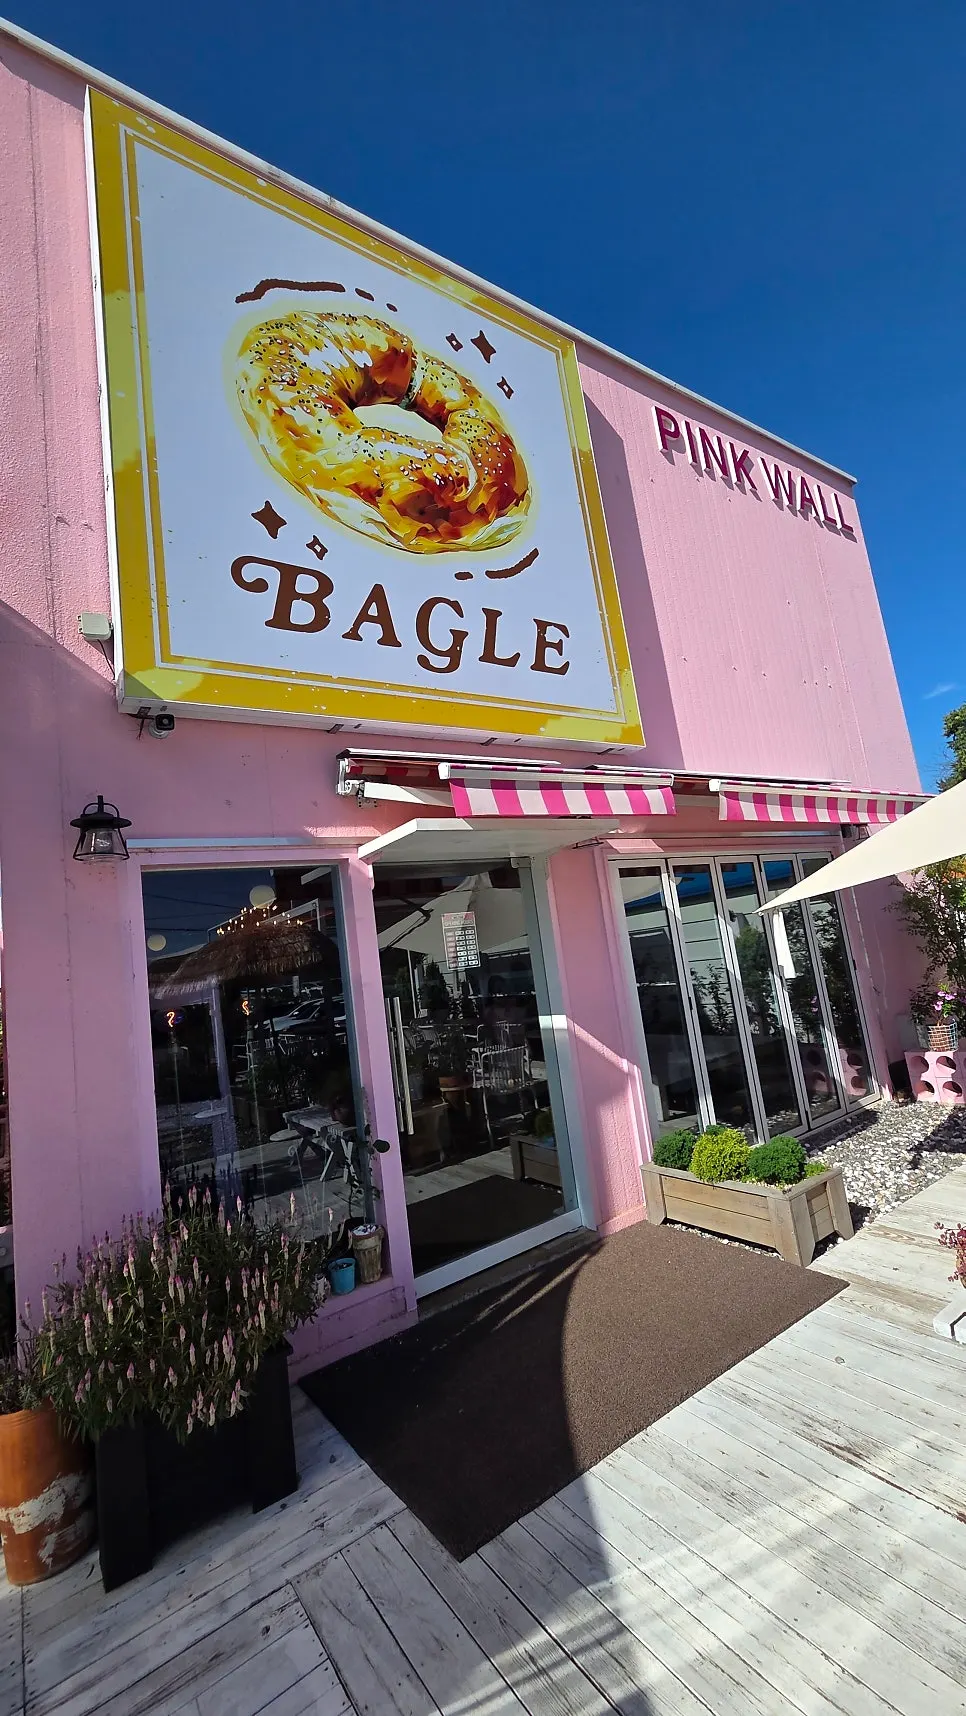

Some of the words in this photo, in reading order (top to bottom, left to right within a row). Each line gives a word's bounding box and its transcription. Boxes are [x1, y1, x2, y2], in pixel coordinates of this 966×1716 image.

[651, 405, 758, 491] PINK
[757, 456, 854, 533] WALL
[230, 555, 571, 675] BAGLE
